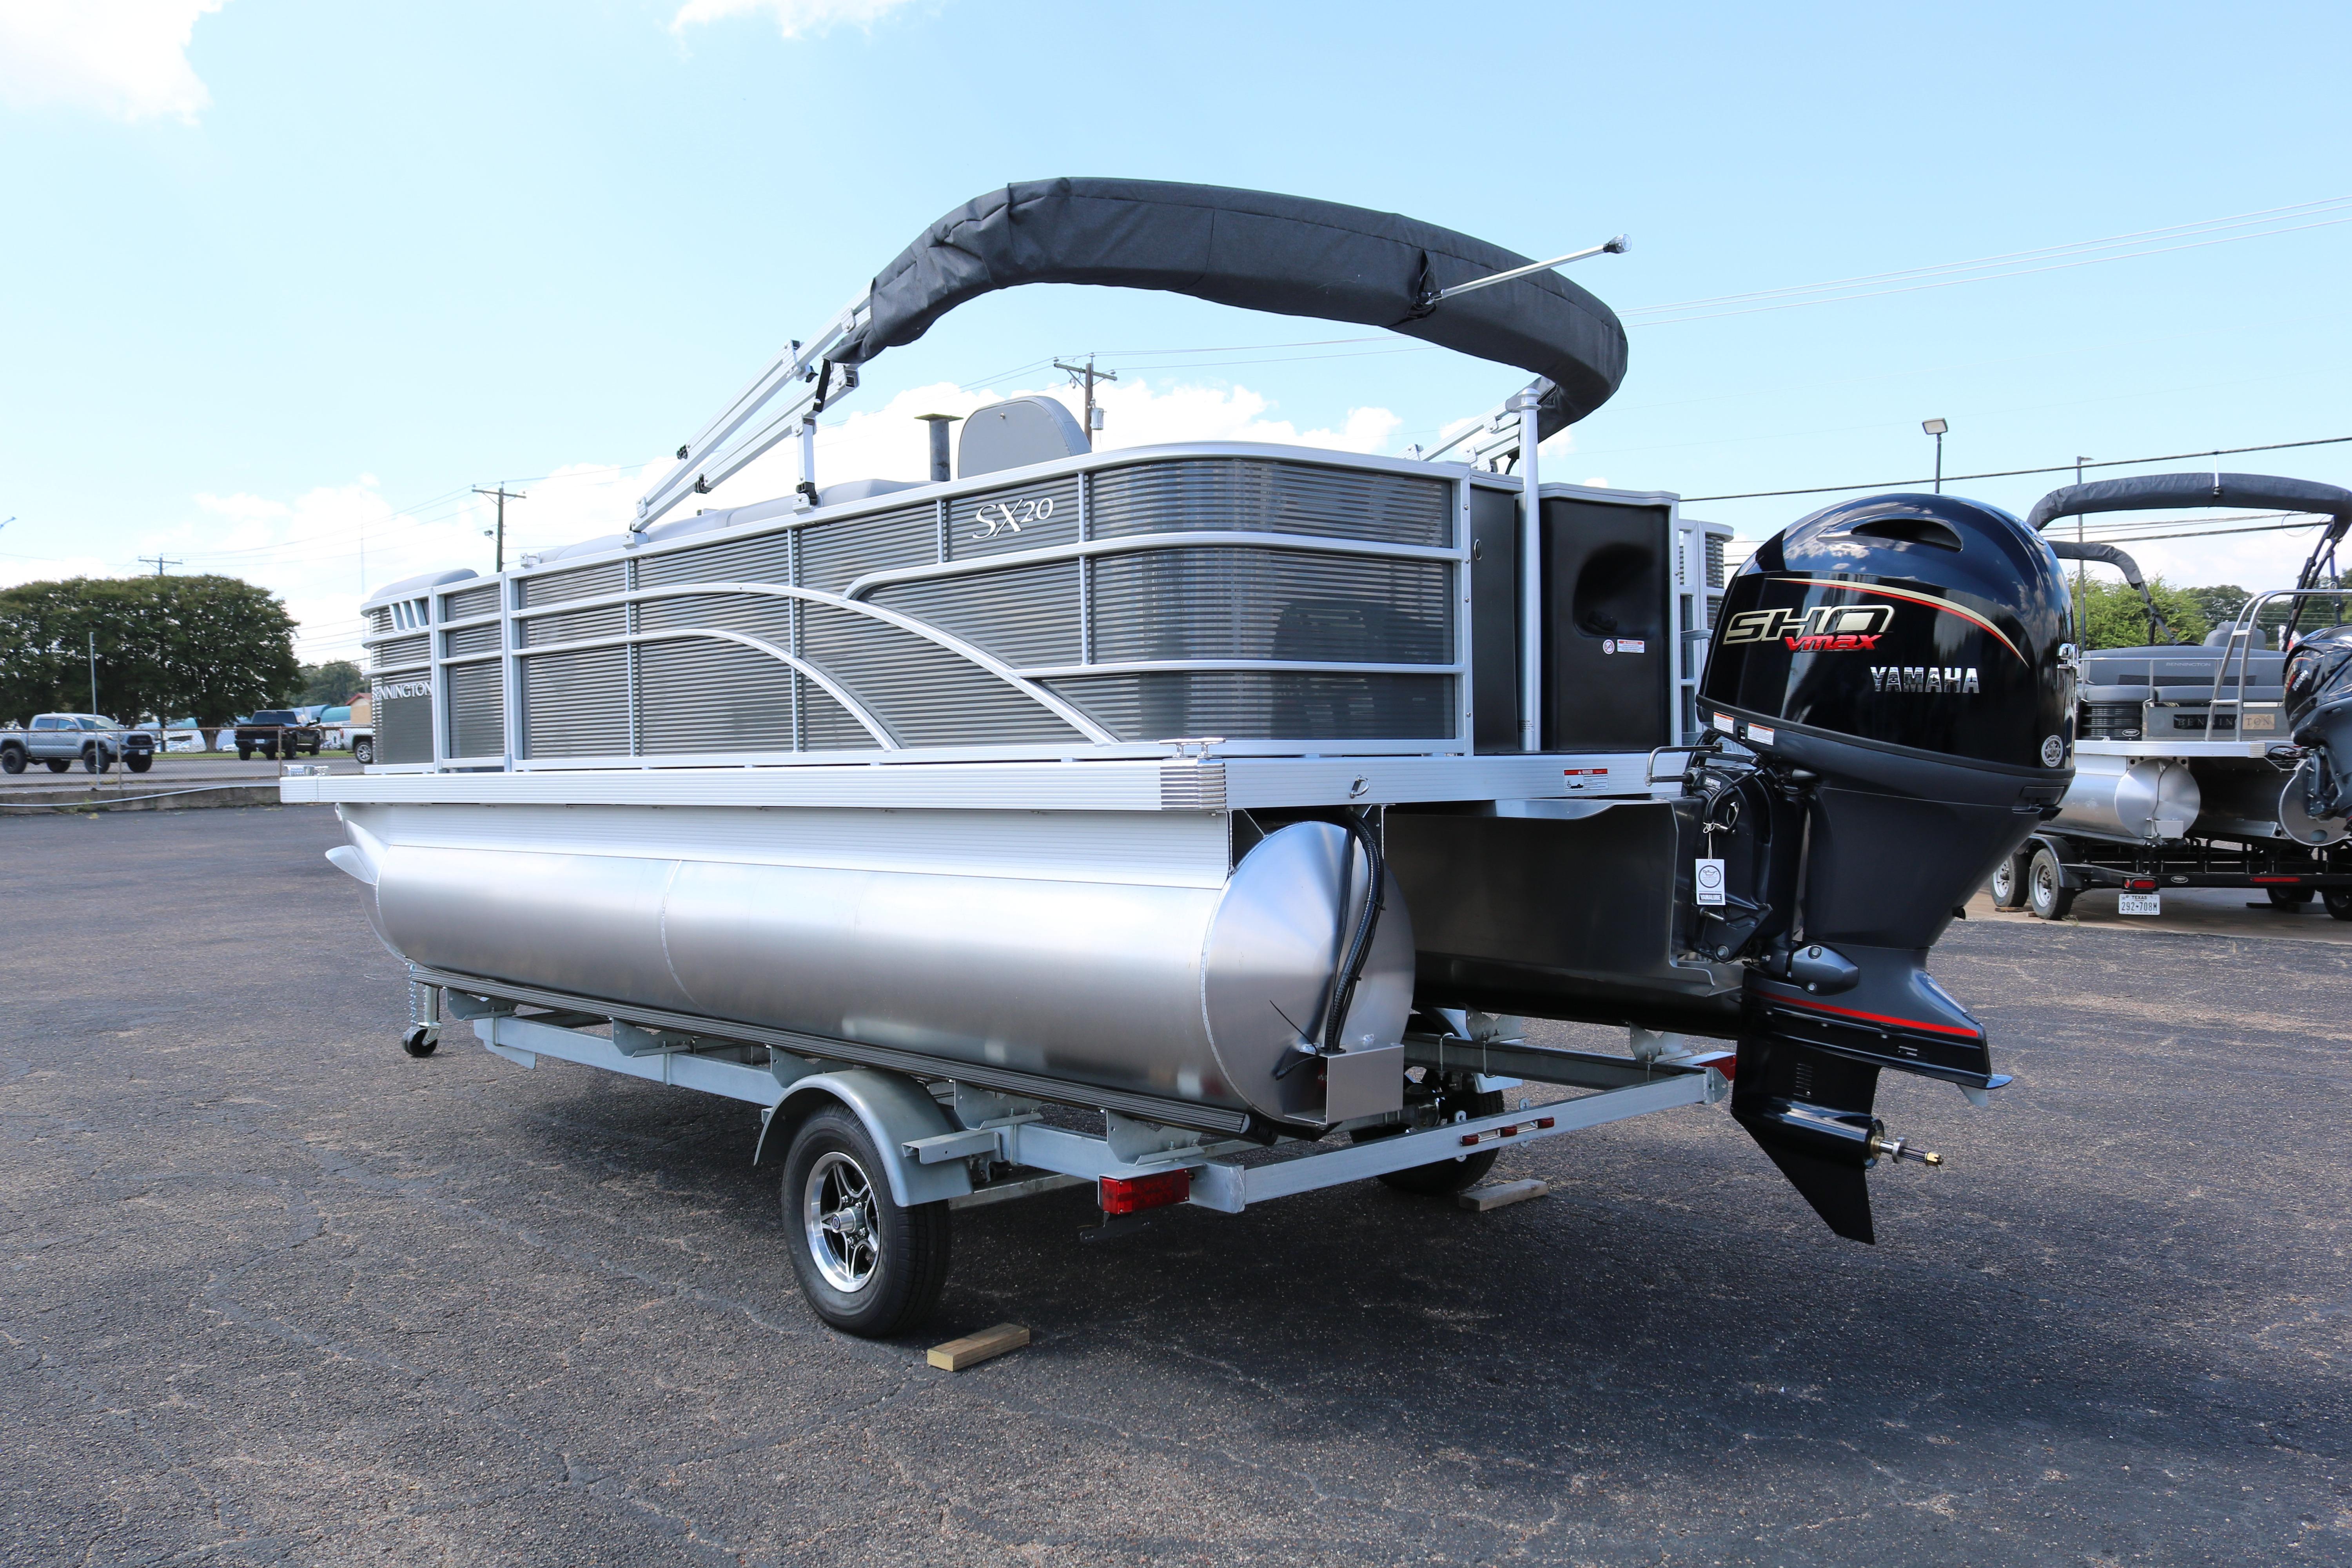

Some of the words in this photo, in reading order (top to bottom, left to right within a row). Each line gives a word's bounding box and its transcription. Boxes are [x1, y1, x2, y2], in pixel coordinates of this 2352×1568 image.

[972, 497, 1054, 539] SX20
[1723, 604, 1895, 644] SHO
[1870, 666, 1980, 693] YAMAHA
[2178, 718, 2270, 726] BENINTON
